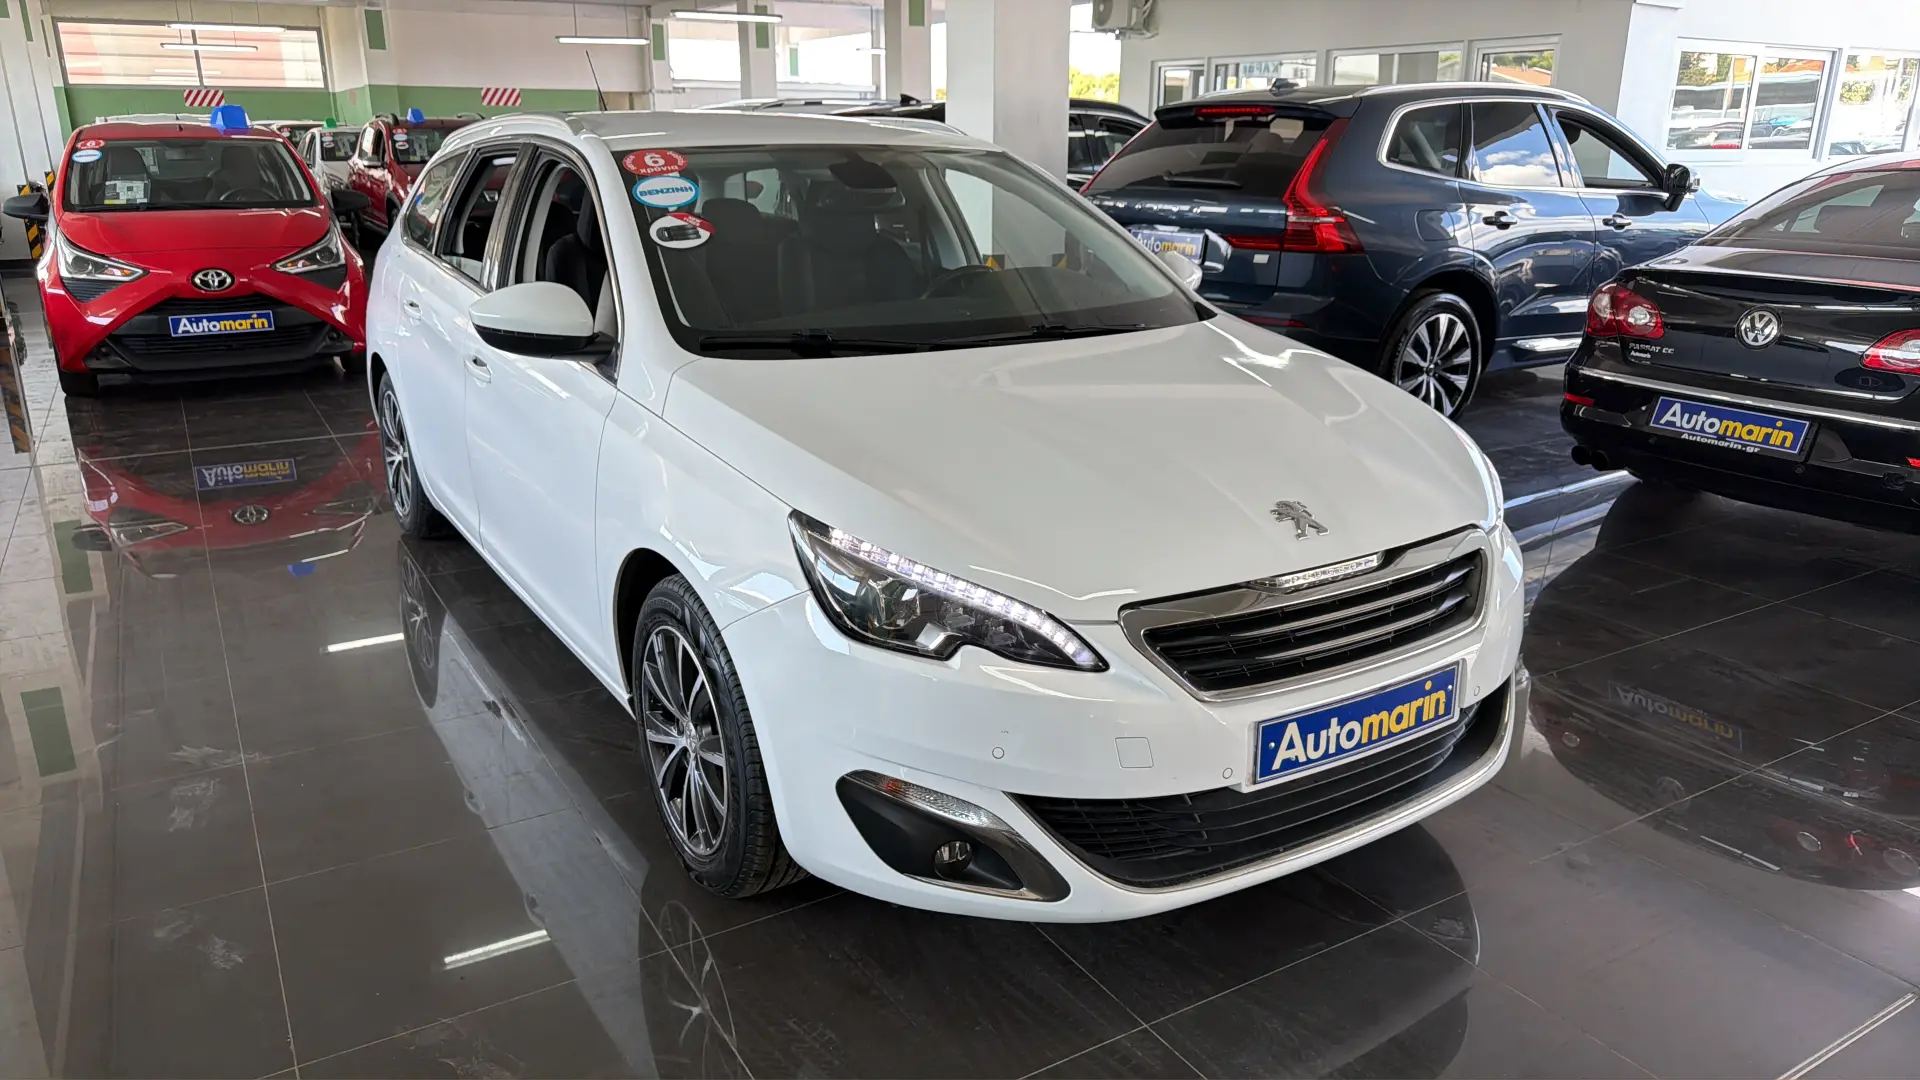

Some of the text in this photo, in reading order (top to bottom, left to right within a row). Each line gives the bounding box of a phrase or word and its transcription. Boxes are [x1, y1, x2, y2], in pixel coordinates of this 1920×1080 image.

[644, 153, 665, 167] 6
[177, 313, 269, 334] Automarin
[1628, 342, 1675, 355] PASSAT CC
[1659, 402, 1794, 448] Automarin
[1681, 432, 1760, 453] Automarin.gr
[1271, 680, 1446, 771] Automarin
